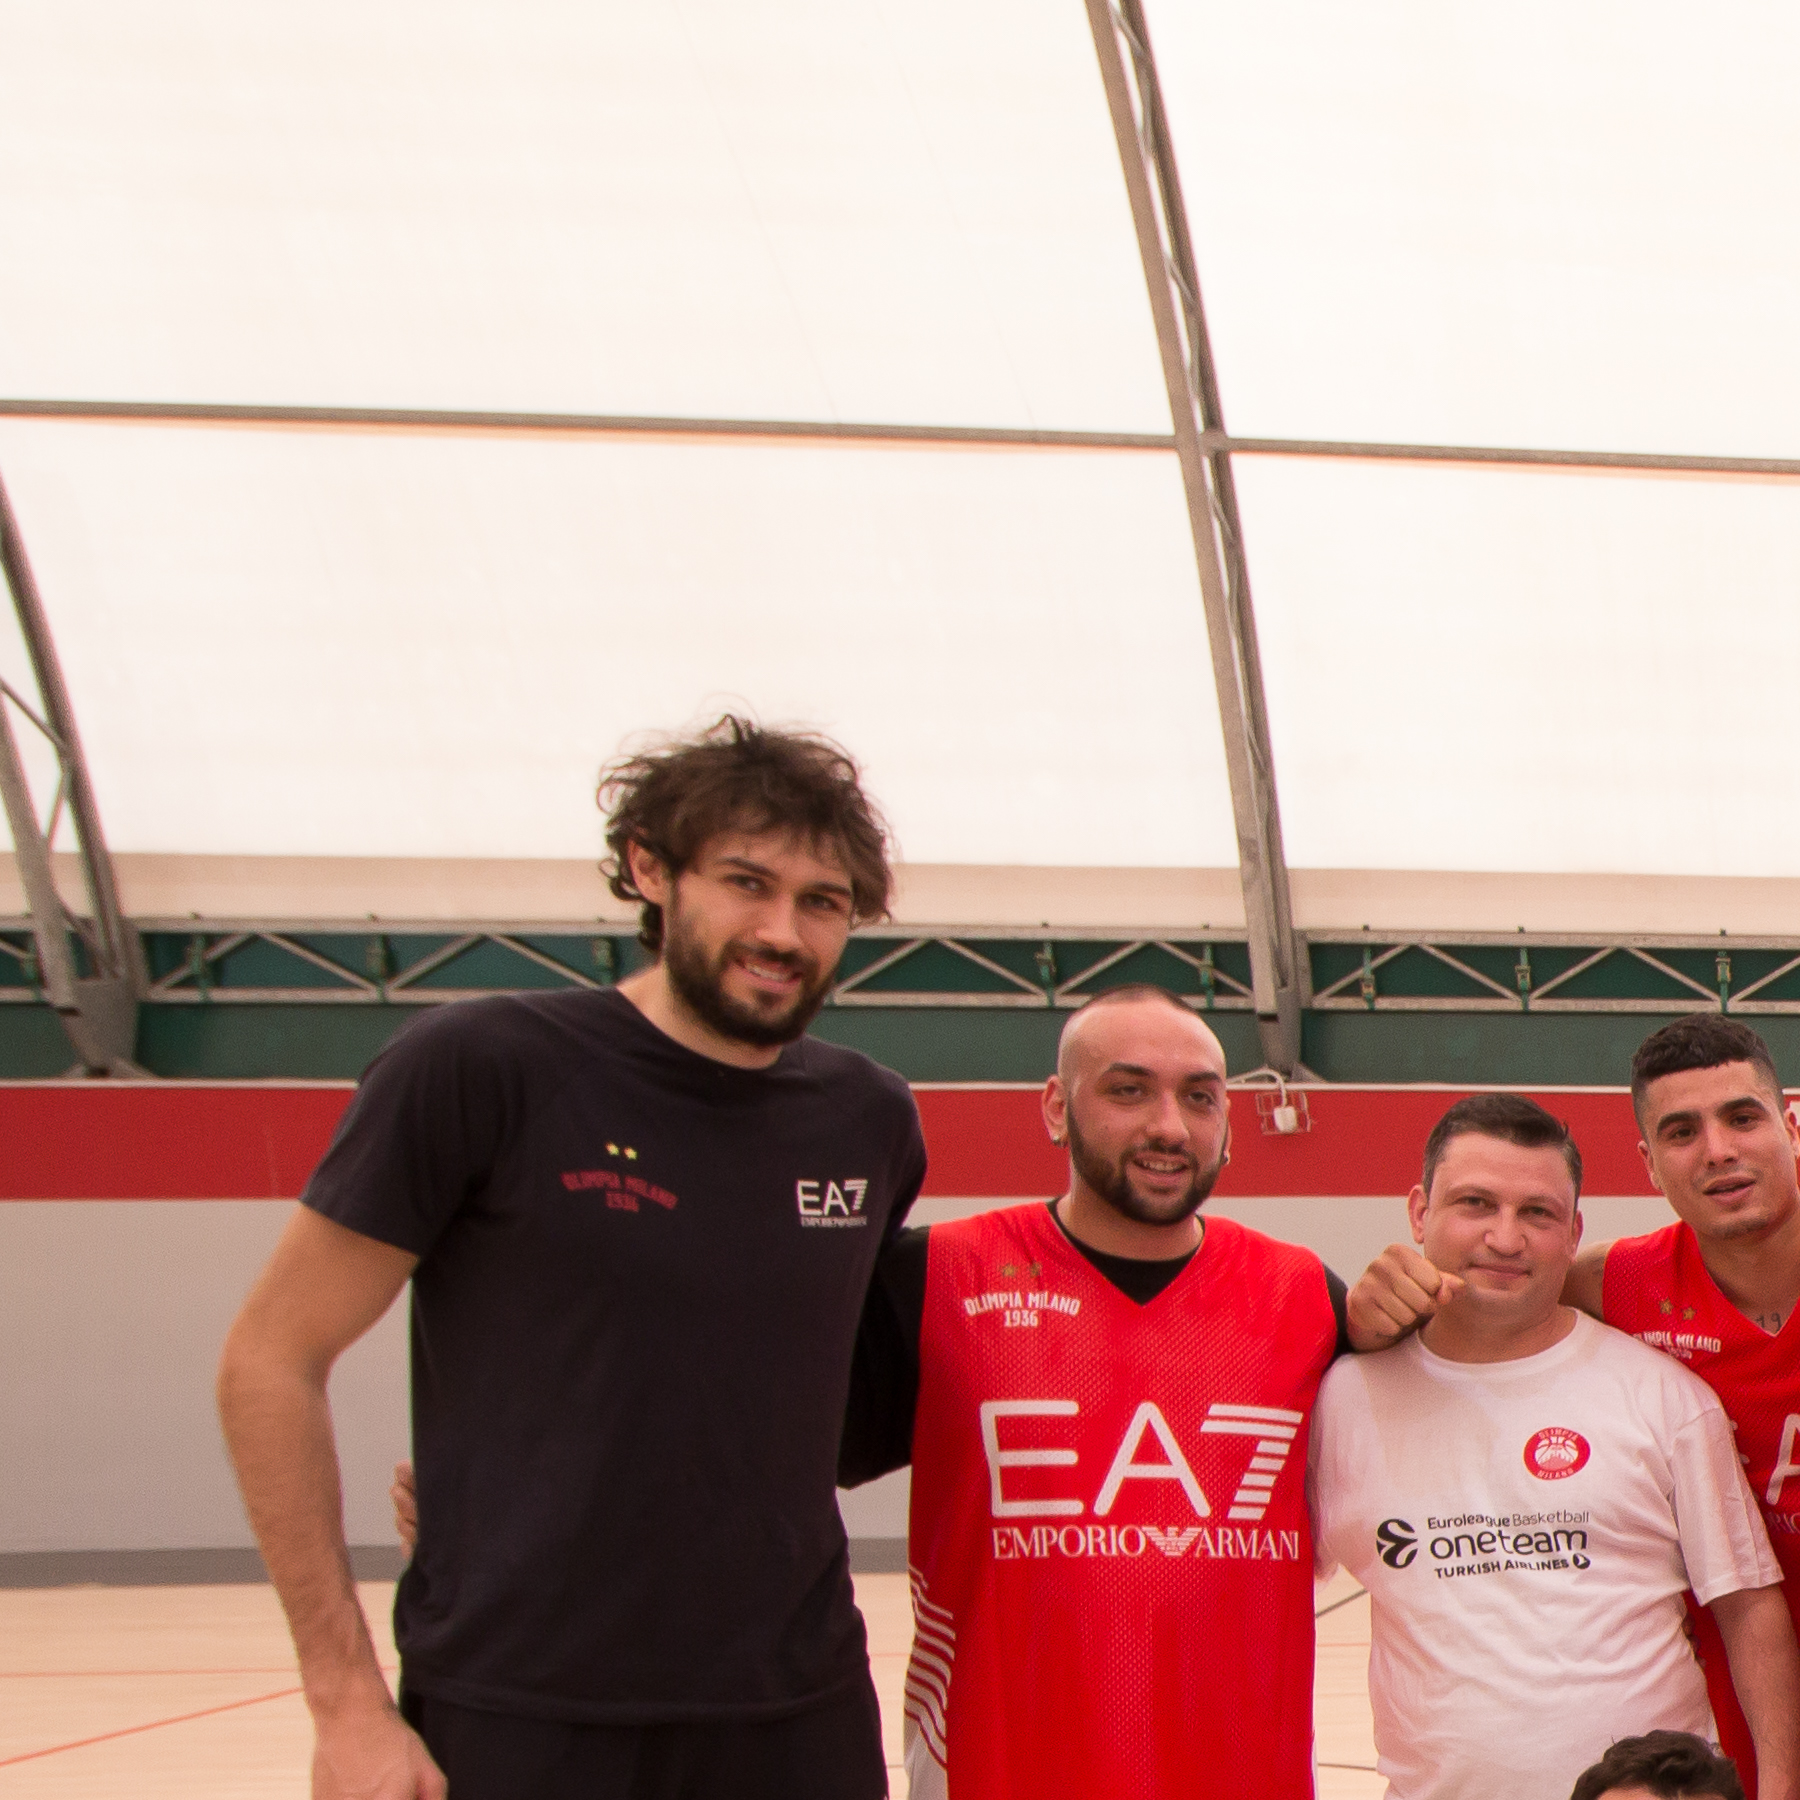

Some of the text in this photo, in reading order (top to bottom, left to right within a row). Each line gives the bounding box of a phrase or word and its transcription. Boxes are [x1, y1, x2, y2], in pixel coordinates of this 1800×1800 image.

[797, 1178, 869, 1216] EA7
[964, 1289, 1081, 1317] OLIMPIA MILANO
[1004, 1309, 1039, 1328] 1936
[980, 1399, 1304, 1521] EA7
[1427, 1509, 1590, 1530] Euroleague Basketball
[992, 1525, 1299, 1561] EMPORIO ARMANI
[1429, 1529, 1588, 1560] oneteam
[1434, 1558, 1570, 1579] TURKISH AIRLINES
